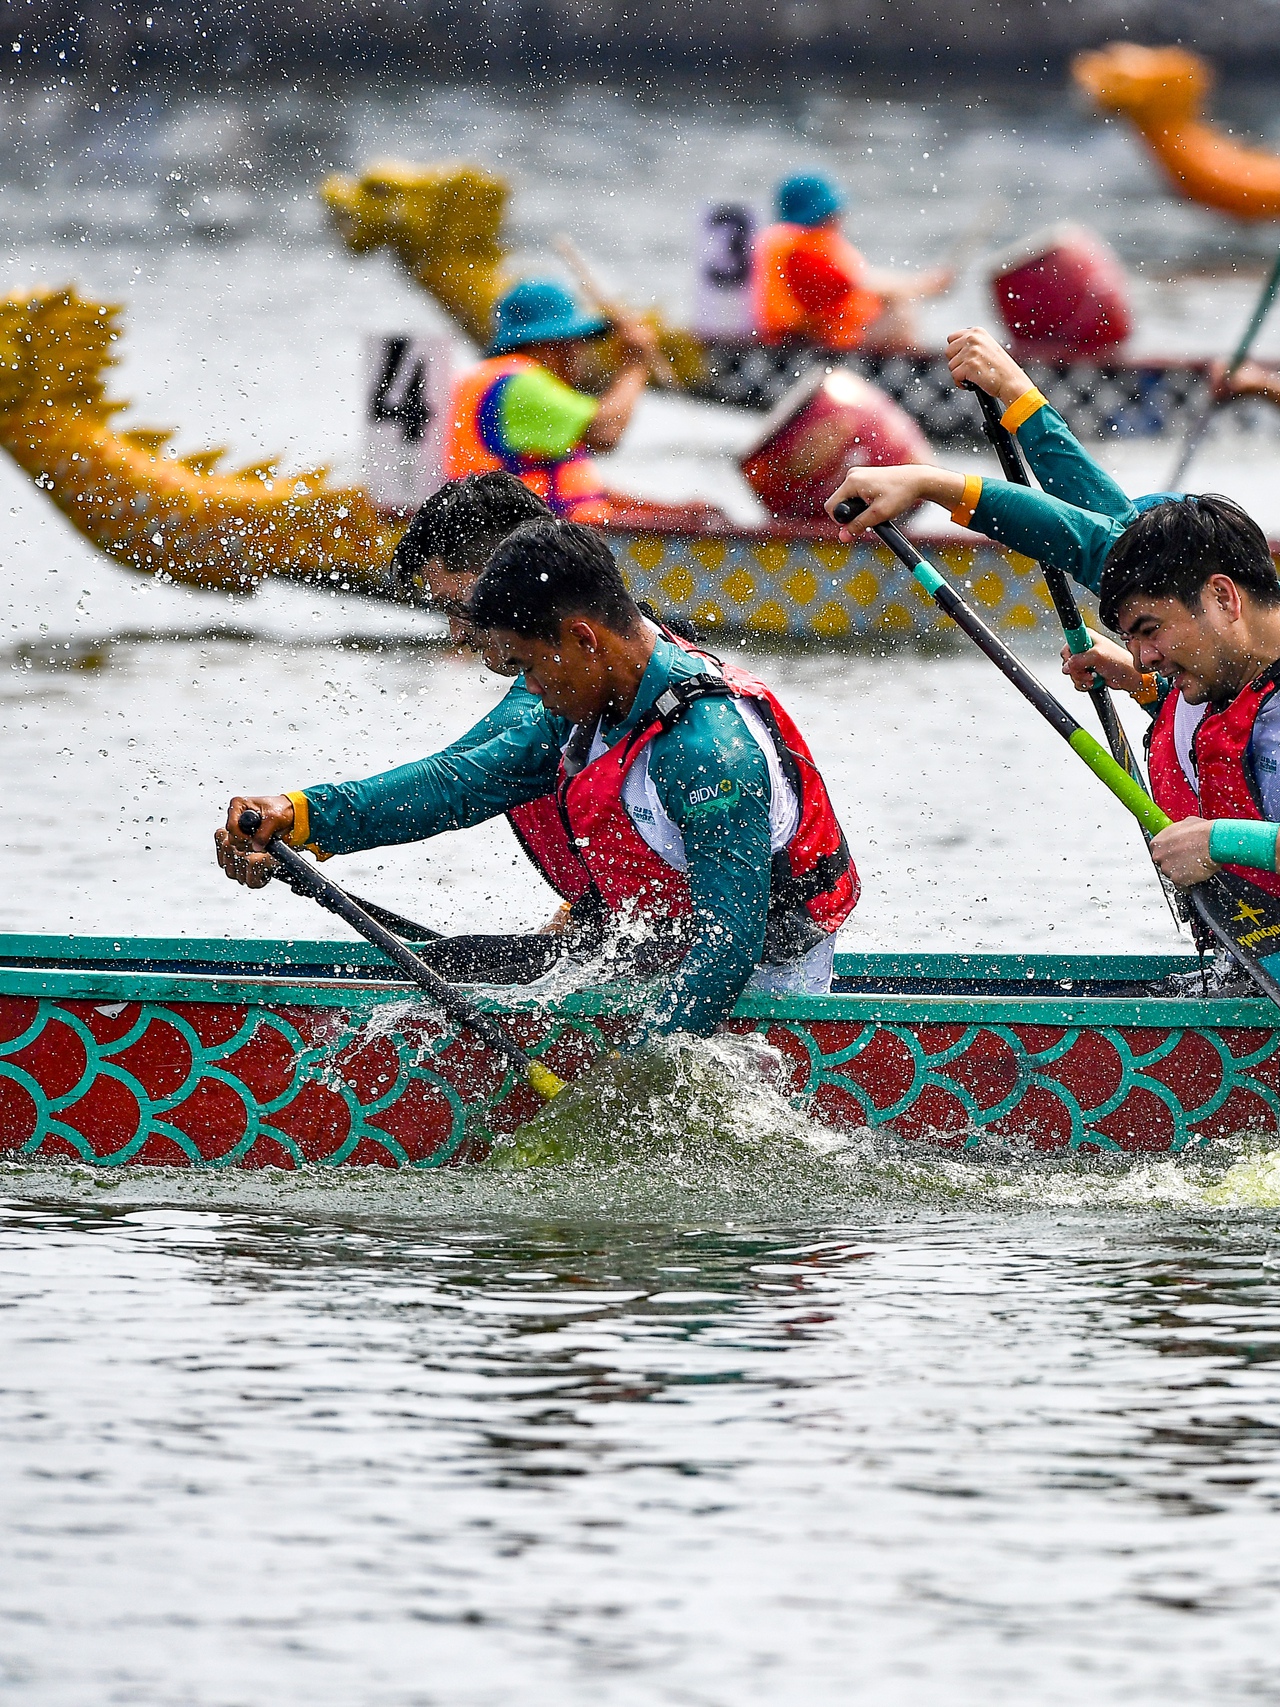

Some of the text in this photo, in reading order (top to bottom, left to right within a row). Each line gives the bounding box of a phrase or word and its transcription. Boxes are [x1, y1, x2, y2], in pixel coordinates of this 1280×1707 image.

[706, 204, 752, 288] 3
[368, 336, 429, 441] 4
[689, 783, 719, 805] BIDV
